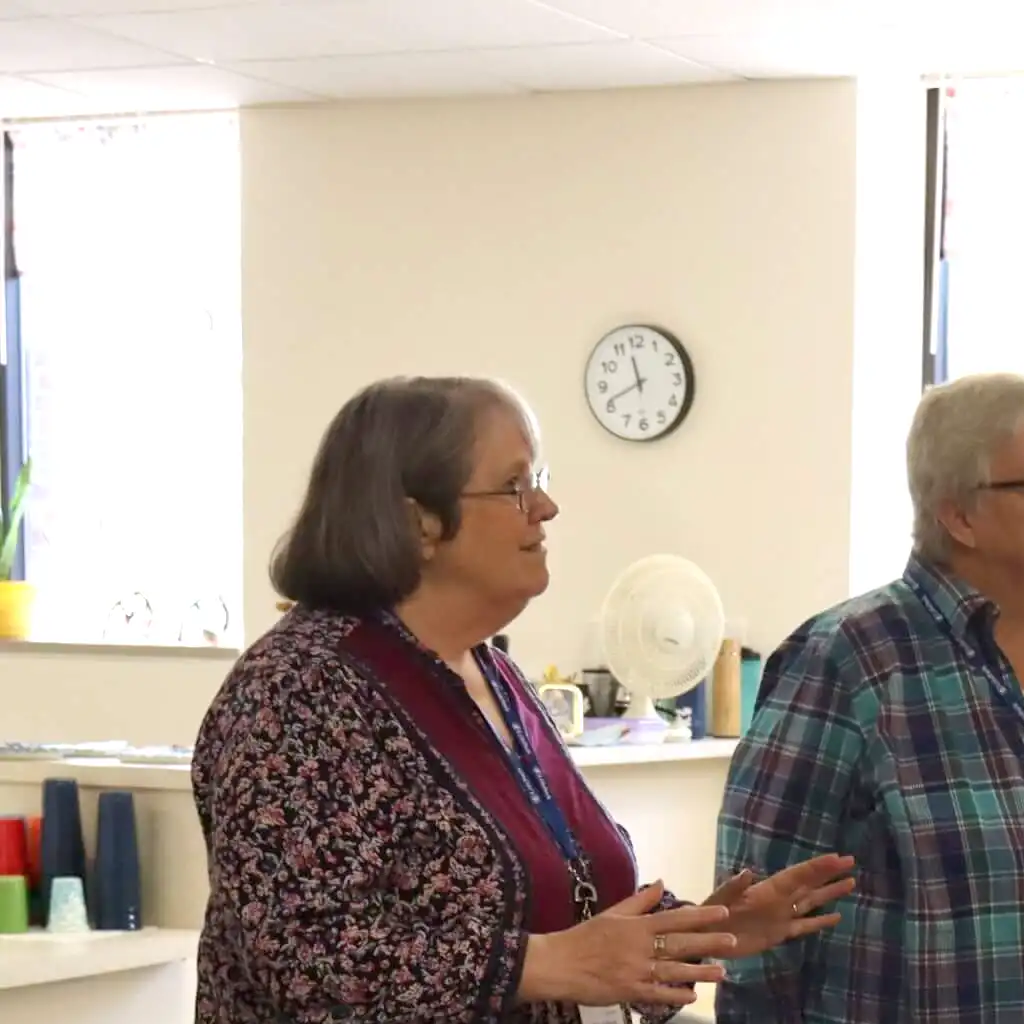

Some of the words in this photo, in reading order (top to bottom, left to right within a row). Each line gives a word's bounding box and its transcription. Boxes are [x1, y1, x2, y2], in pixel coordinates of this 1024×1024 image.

[628, 334, 645, 349] 12
[652, 339, 658, 353] 1
[613, 342, 625, 357] 11
[601, 360, 618, 374] 10
[663, 352, 676, 367] 2
[671, 371, 682, 387] 3
[598, 380, 608, 394] 9
[667, 392, 678, 407] 4
[621, 413, 632, 428] 7
[639, 417, 649, 431] 6
[656, 409, 666, 425] 5
